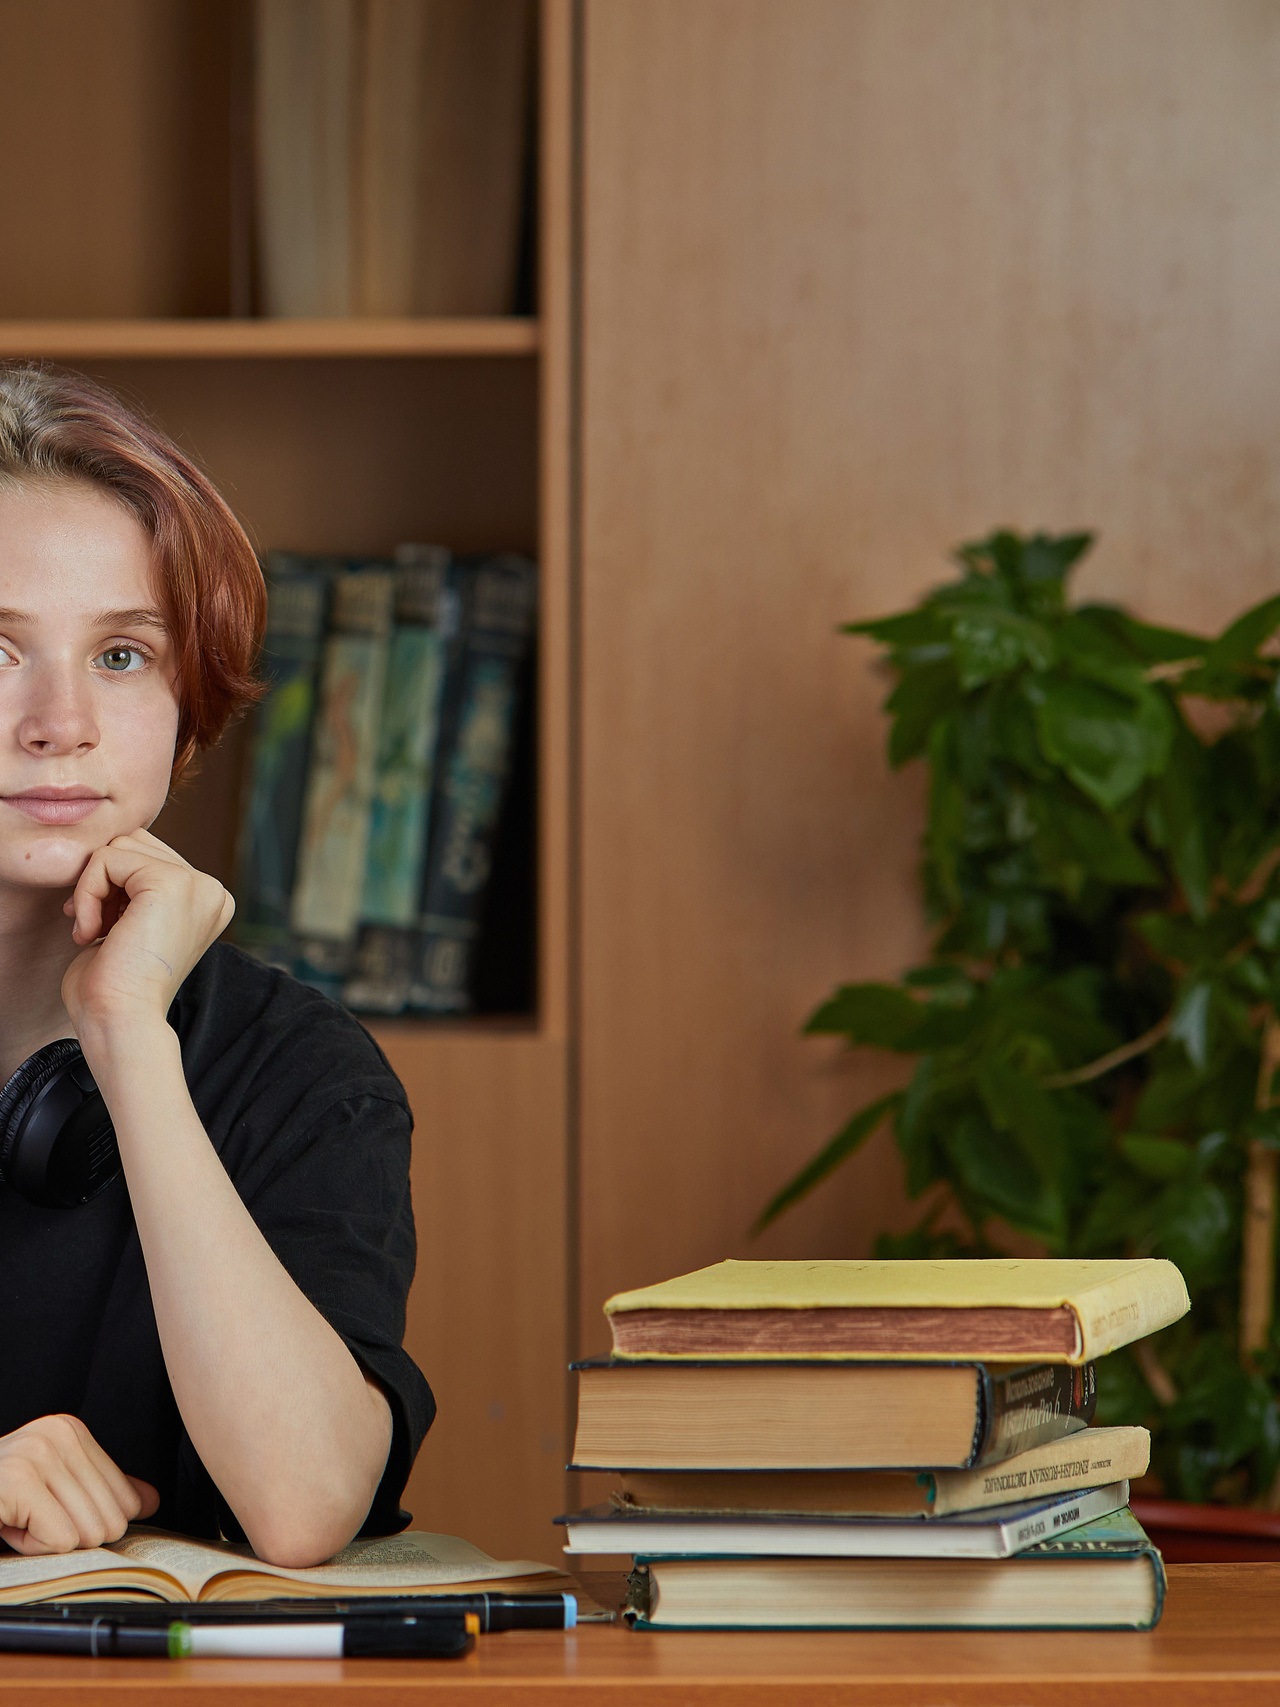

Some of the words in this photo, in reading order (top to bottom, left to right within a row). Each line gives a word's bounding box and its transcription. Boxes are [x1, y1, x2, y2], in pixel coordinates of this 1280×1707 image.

[1054, 1388, 1062, 1421] 6
[984, 1472, 1027, 1493] DICTIONARY
[1029, 1460, 1090, 1485] ENGLISH-RUSSIAN
